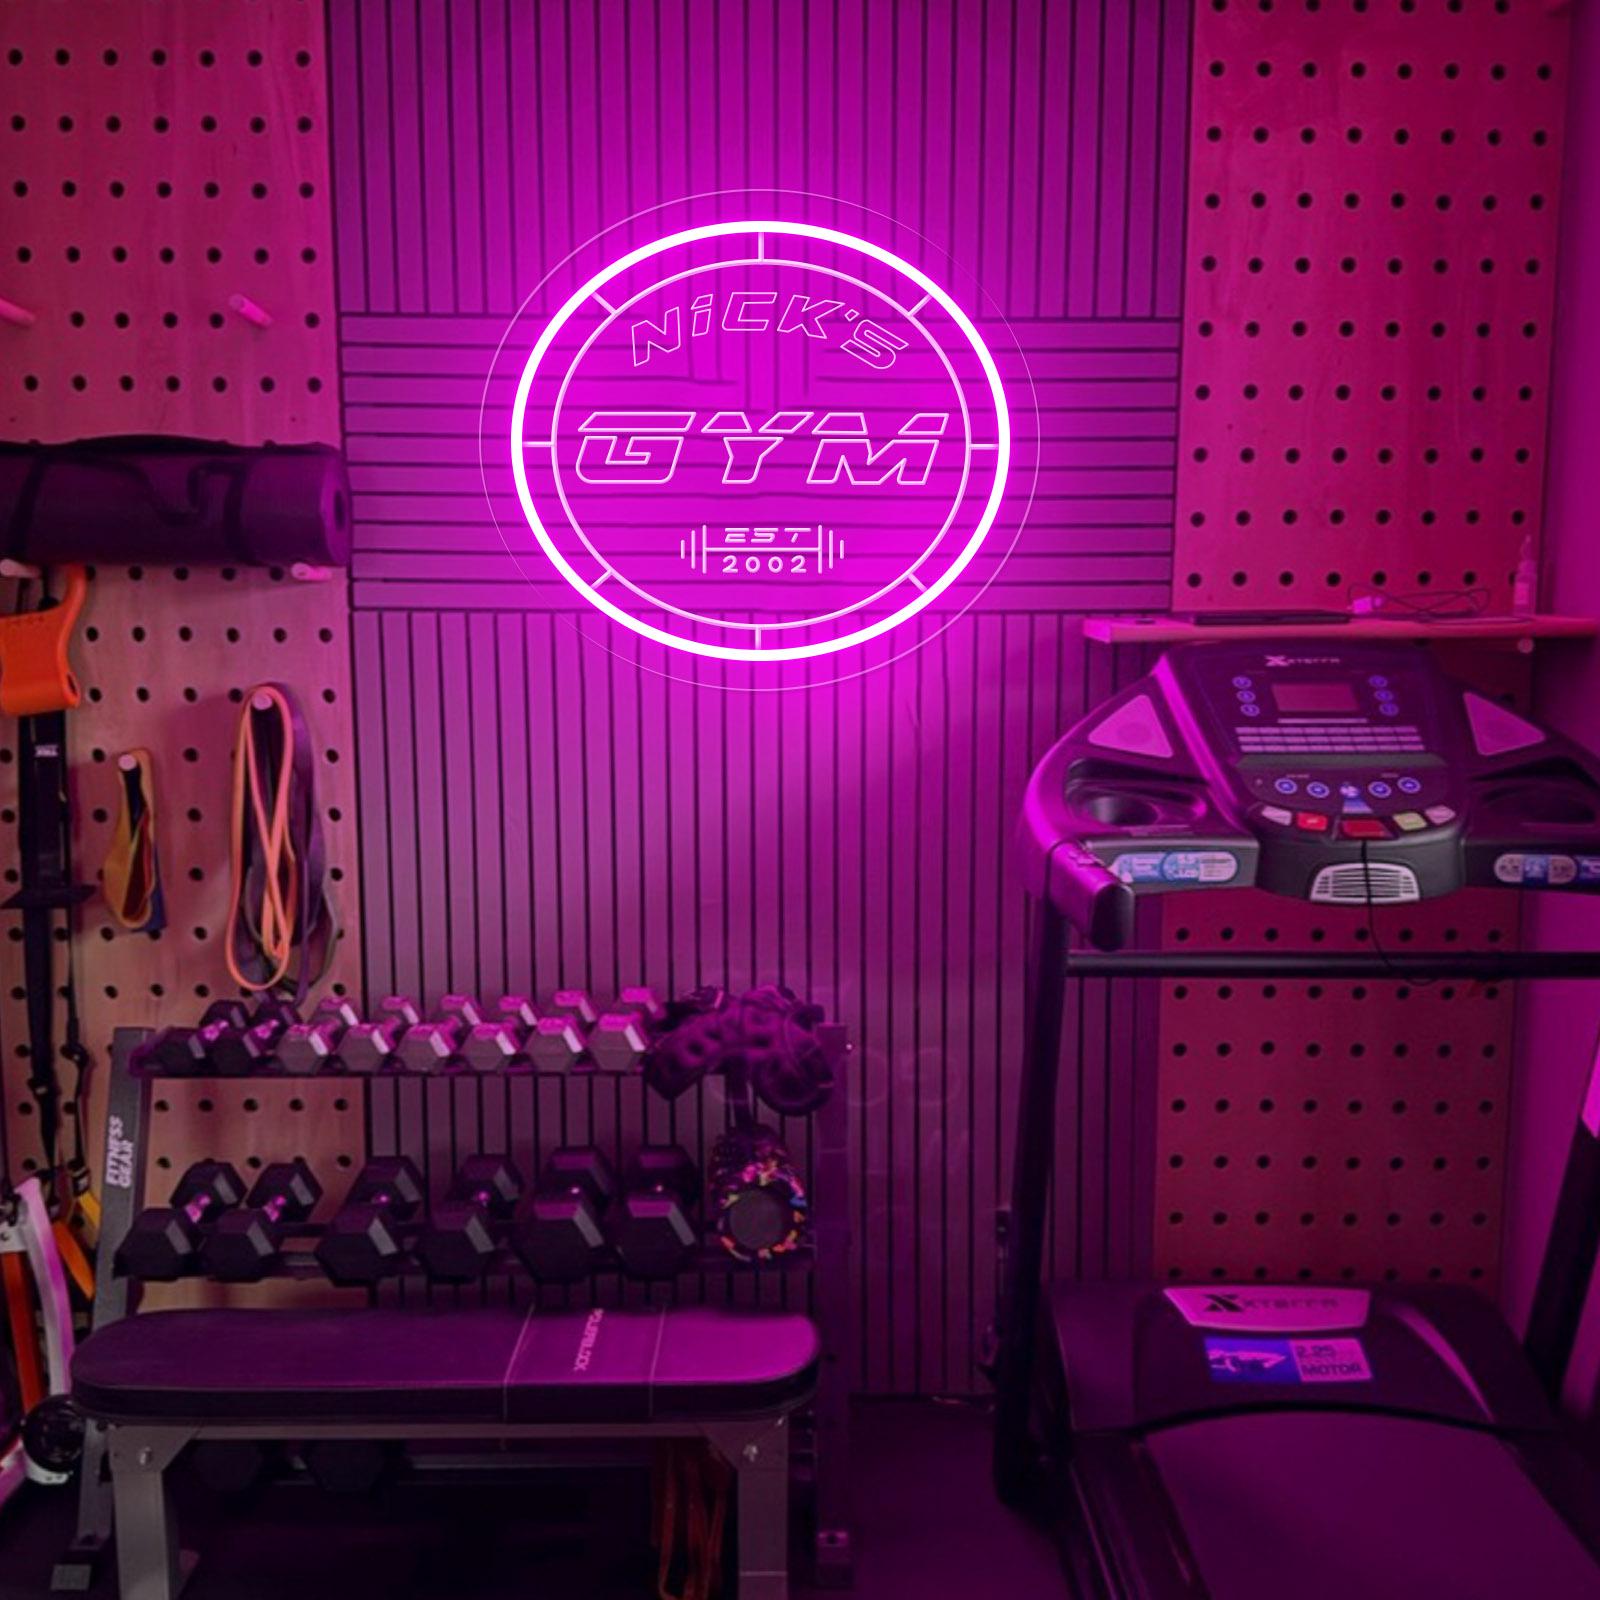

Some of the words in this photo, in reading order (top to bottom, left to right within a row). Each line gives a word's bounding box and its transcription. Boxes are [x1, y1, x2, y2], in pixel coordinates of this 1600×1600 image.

[575, 411, 949, 486] GYM
[724, 527, 812, 544] EST
[722, 554, 808, 574] 2002
